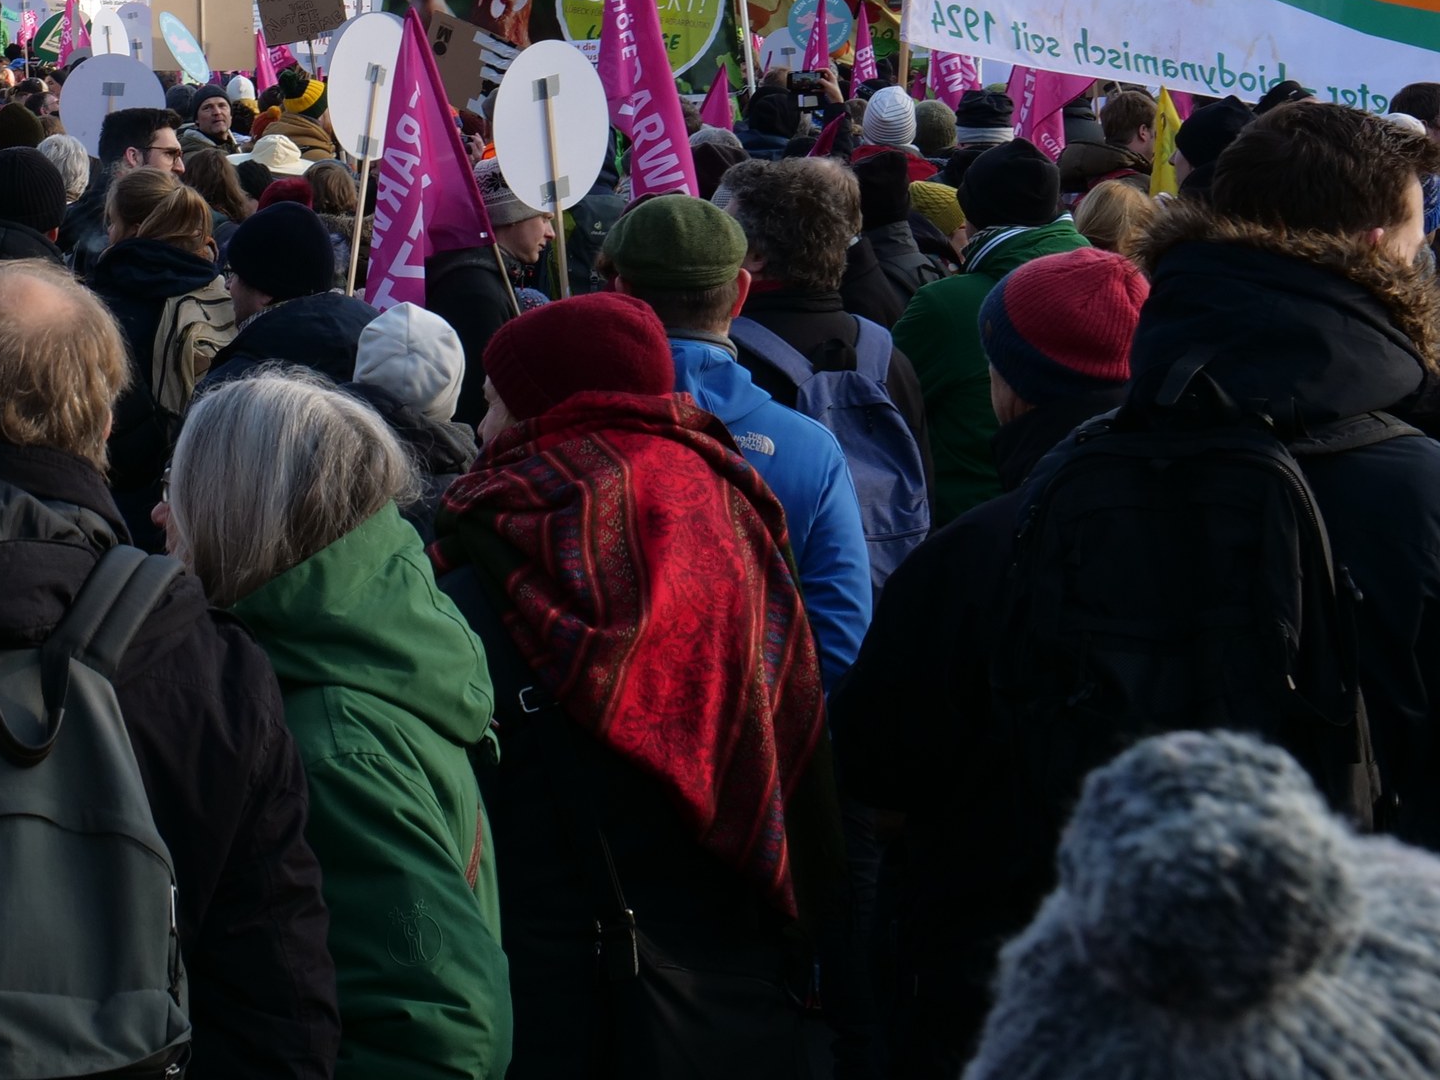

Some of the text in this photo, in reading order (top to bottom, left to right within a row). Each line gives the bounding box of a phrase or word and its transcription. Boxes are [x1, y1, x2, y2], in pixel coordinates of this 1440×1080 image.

[582, 42, 597, 51] die
[746, 431, 764, 440] THE
[733, 435, 763, 447] NORTH
[740, 442, 764, 452] FACE
